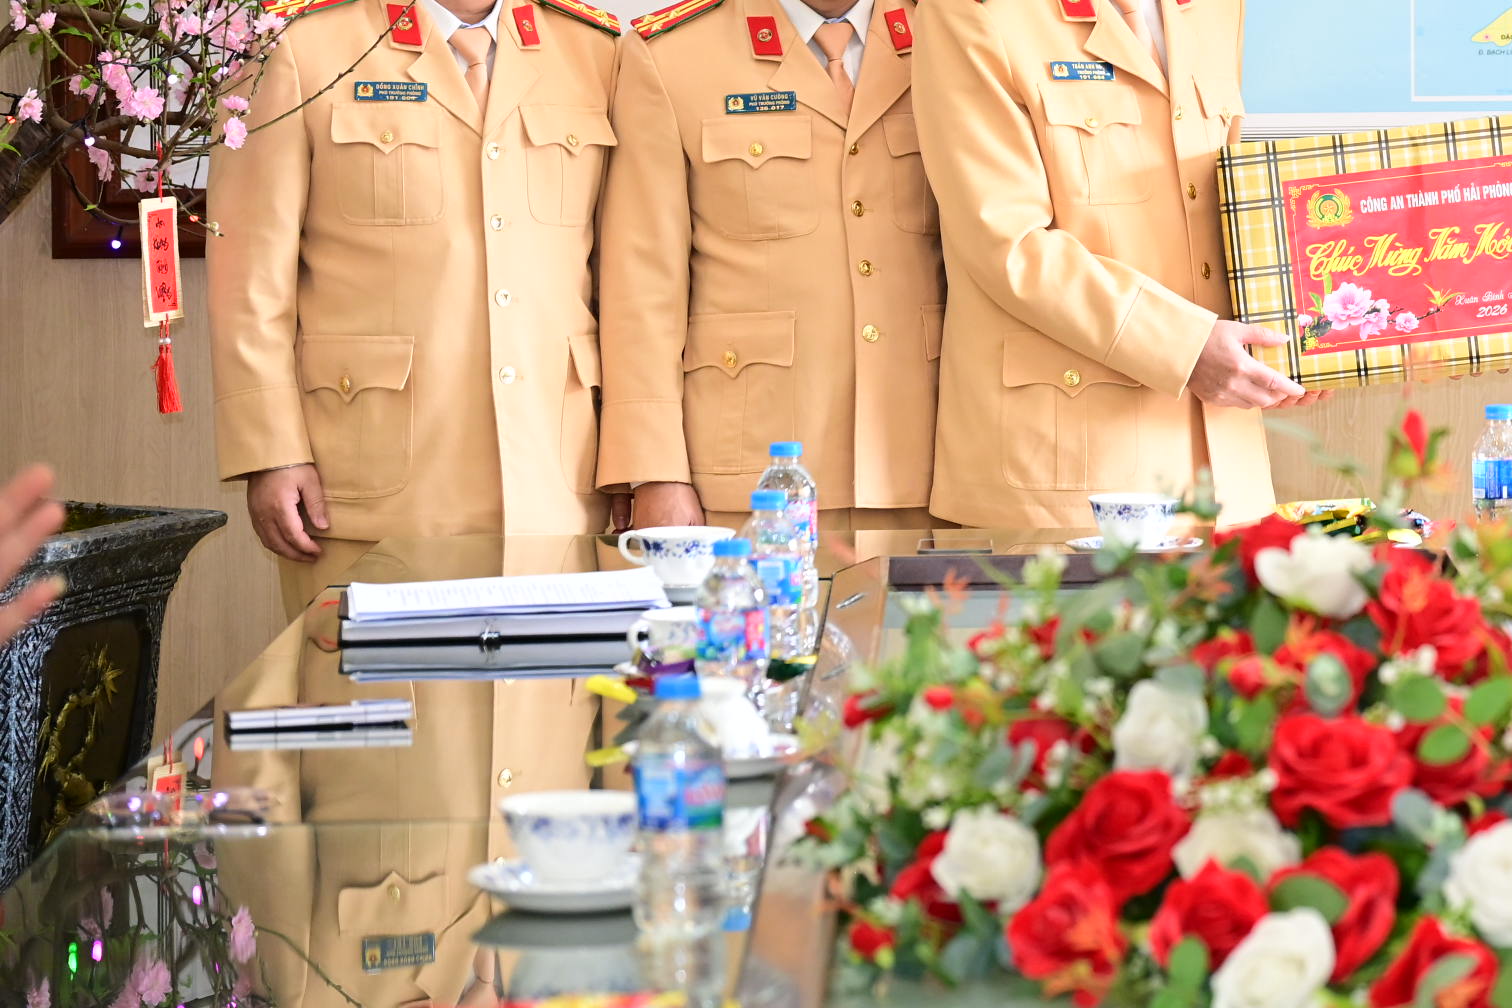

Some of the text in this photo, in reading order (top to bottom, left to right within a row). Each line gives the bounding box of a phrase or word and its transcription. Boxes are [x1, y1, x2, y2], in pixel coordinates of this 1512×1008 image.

[1359, 196, 1389, 214] CÔNG
[1389, 196, 1405, 211] AN
[1405, 191, 1440, 208] THÀNH
[1440, 186, 1462, 205] PHỐ
[1462, 184, 1481, 203] HẢI
[1304, 239, 1364, 282] Chúc
[1359, 232, 1423, 277] Mừng
[1424, 225, 1470, 265] Năm
[1453, 292, 1481, 307] Xuân
[1475, 303, 1509, 319] 2026
